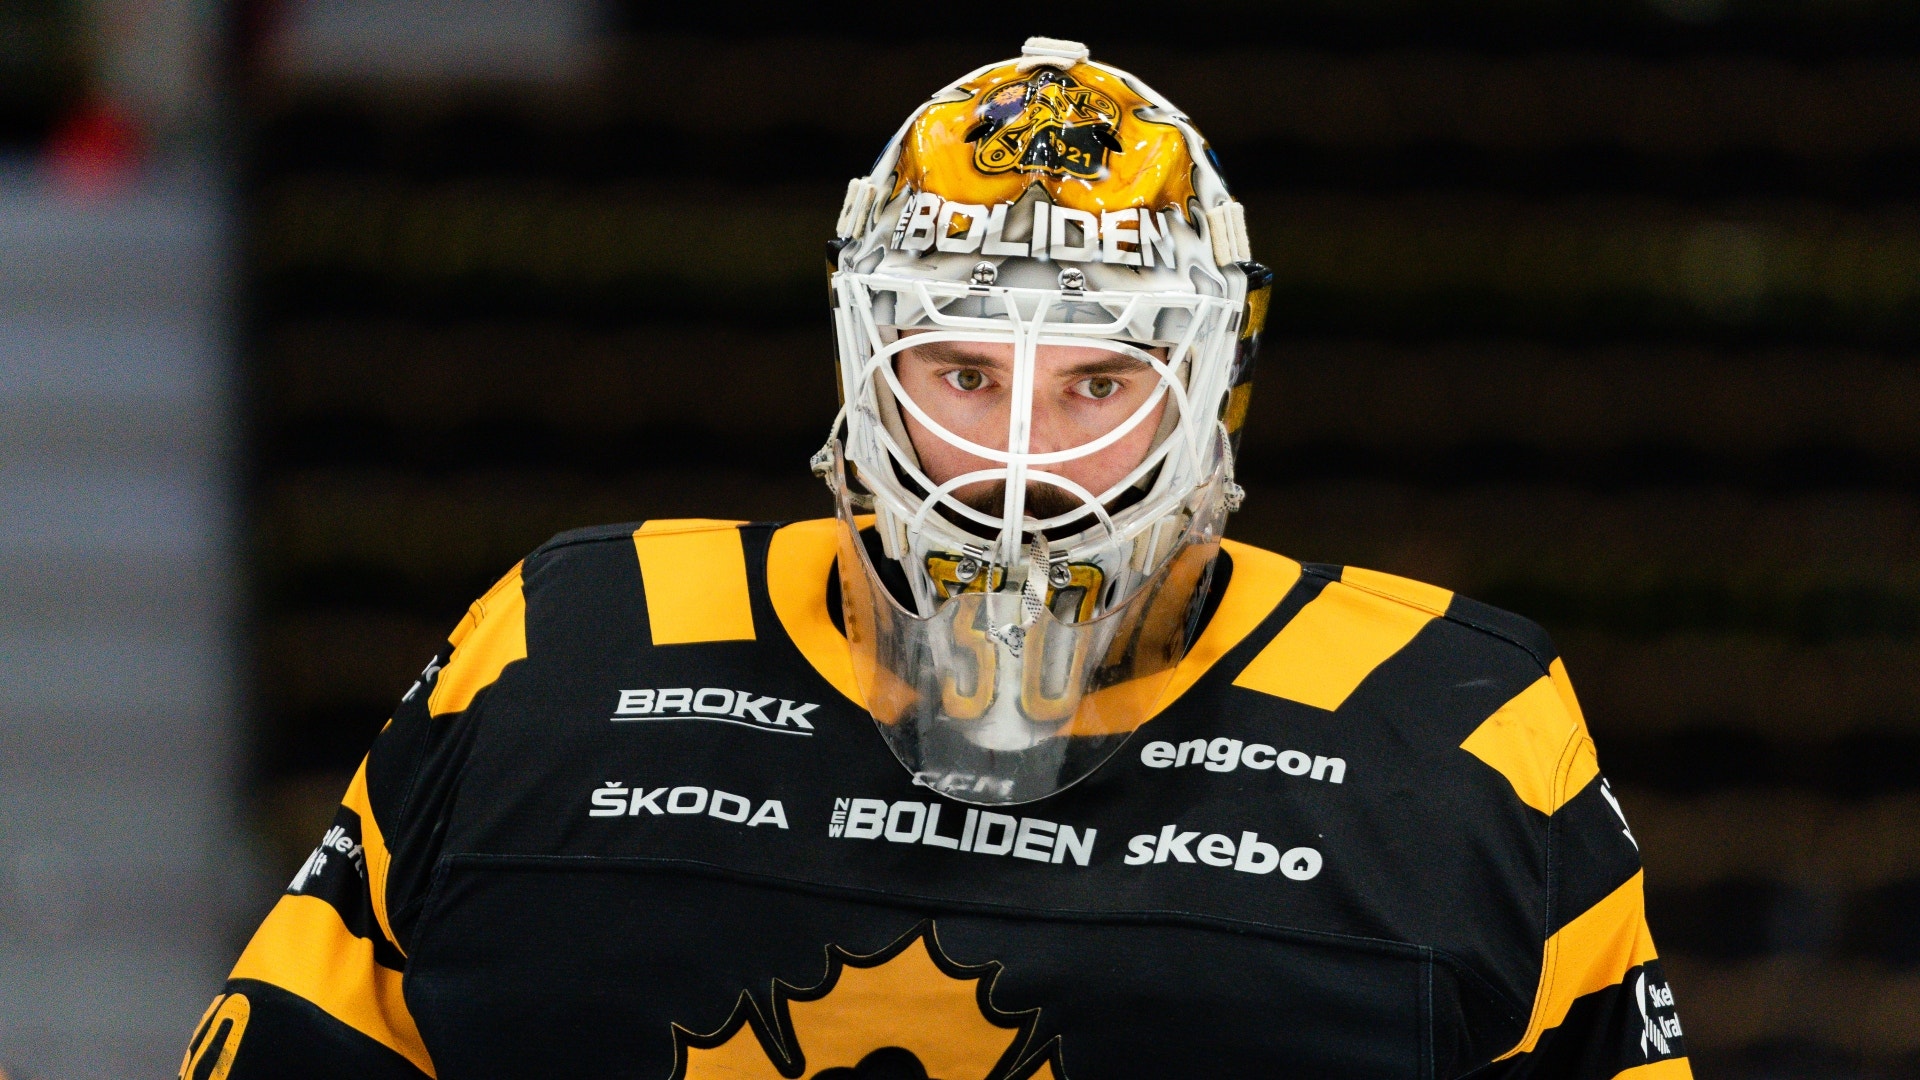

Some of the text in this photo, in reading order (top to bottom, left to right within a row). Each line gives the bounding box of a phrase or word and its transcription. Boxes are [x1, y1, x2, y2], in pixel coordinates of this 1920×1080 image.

[1049, 130, 1092, 168] 1921
[890, 192, 1176, 269] NEW BOLIDEN
[613, 687, 821, 730] BROKK
[1140, 736, 1347, 784] engcon
[588, 781, 789, 829] ŠKODA
[828, 797, 1097, 866] NEW BOLIDEN
[1124, 824, 1323, 881] skebo
